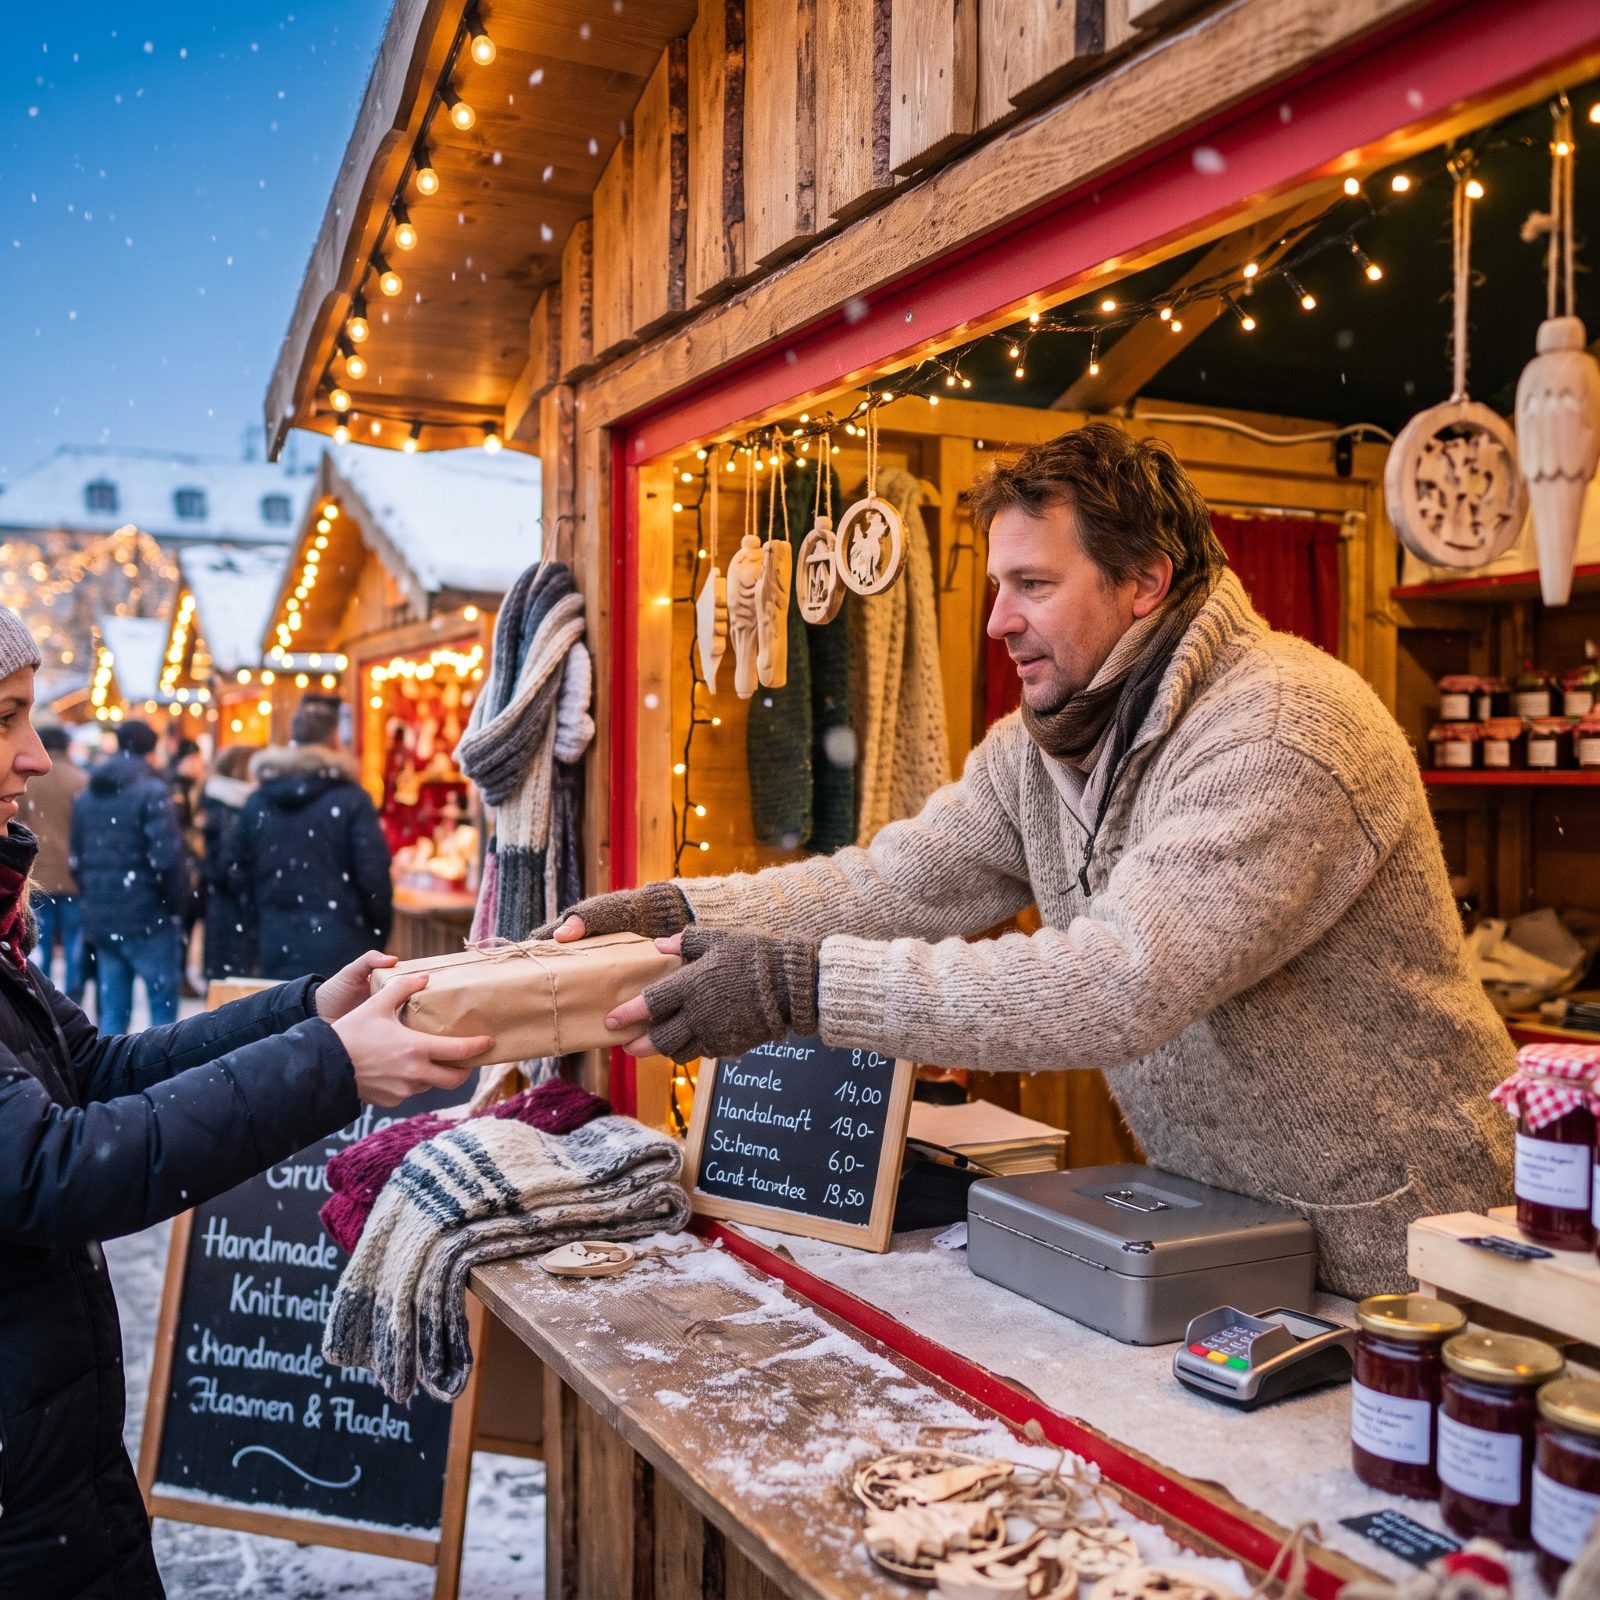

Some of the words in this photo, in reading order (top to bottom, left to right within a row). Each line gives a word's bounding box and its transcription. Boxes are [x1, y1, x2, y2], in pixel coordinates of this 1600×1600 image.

[834, 1080, 882, 1106] 14,00
[829, 1116, 875, 1141] 19,0-
[828, 1150, 865, 1174] 6,0-
[201, 1215, 338, 1270] Handmade
[302, 1393, 323, 1429] &
